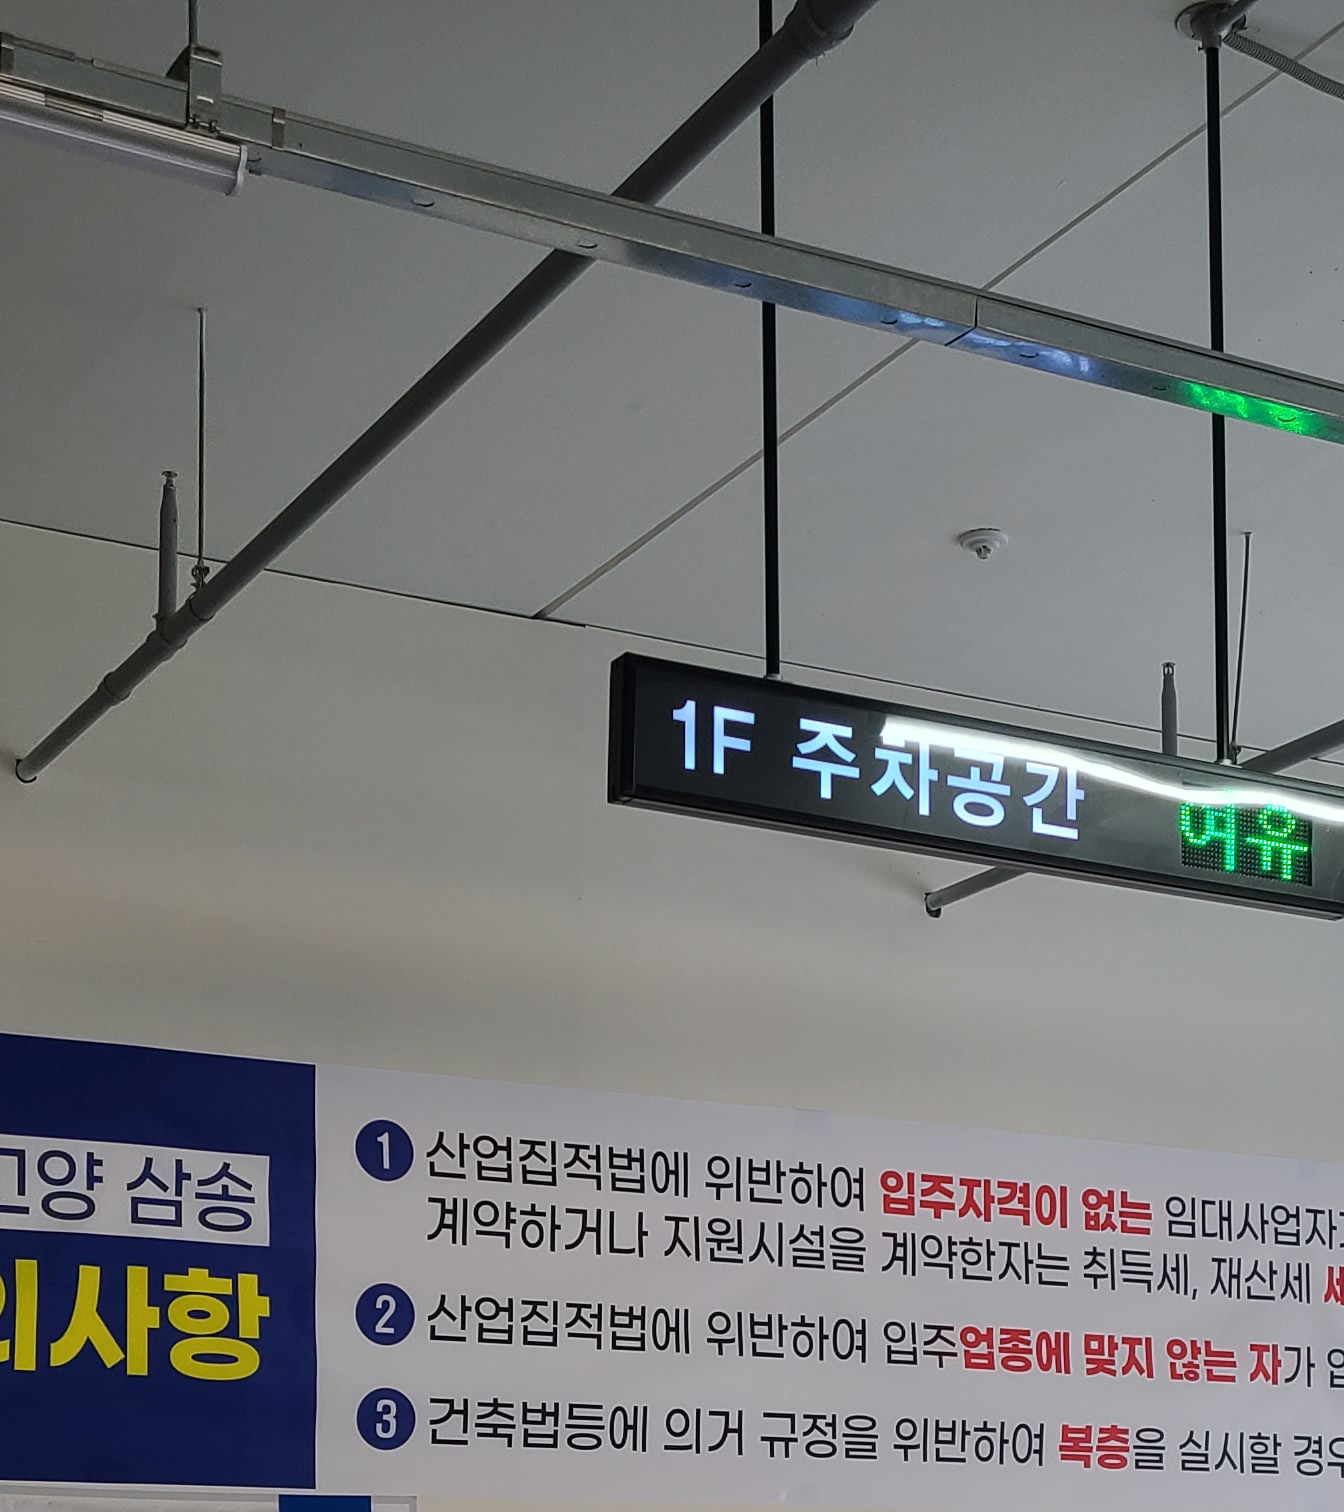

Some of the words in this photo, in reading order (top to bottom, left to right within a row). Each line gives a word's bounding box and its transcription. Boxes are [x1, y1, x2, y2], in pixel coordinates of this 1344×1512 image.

[672, 699, 755, 776] 1F
[792, 716, 1085, 840] 주차공간
[1179, 786, 1311, 881] 여유
[126, 1155, 256, 1232] 삼송
[425, 1132, 688, 1199] 산업집적법에
[704, 1154, 865, 1212] 위반하여
[878, 1169, 1069, 1229] 입주자격이
[1081, 1189, 1153, 1236] 없는
[426, 1198, 648, 1259] 계약하거나
[664, 1213, 866, 1273] 지원시설을
[880, 1232, 1070, 1288] 계약한자는
[1082, 1247, 1198, 1301] 취득세,
[1210, 1256, 1312, 1306] 재산세
[427, 1296, 690, 1356] 산업집적법에
[706, 1311, 867, 1364] 위반하여
[882, 1321, 1071, 1375] 입주업종에
[1083, 1332, 1155, 1379] 맞지
[1167, 1340, 1238, 1384] 않는
[1249, 1343, 1315, 1389] 자가
[427, 1398, 648, 1452] 건축법등에
[664, 1407, 742, 1456] 의거
[759, 1411, 878, 1461] 규정을
[892, 1416, 1044, 1466] 위반하여
[1058, 1423, 1166, 1471] 복층을
[1178, 1430, 1281, 1475] 실시할
